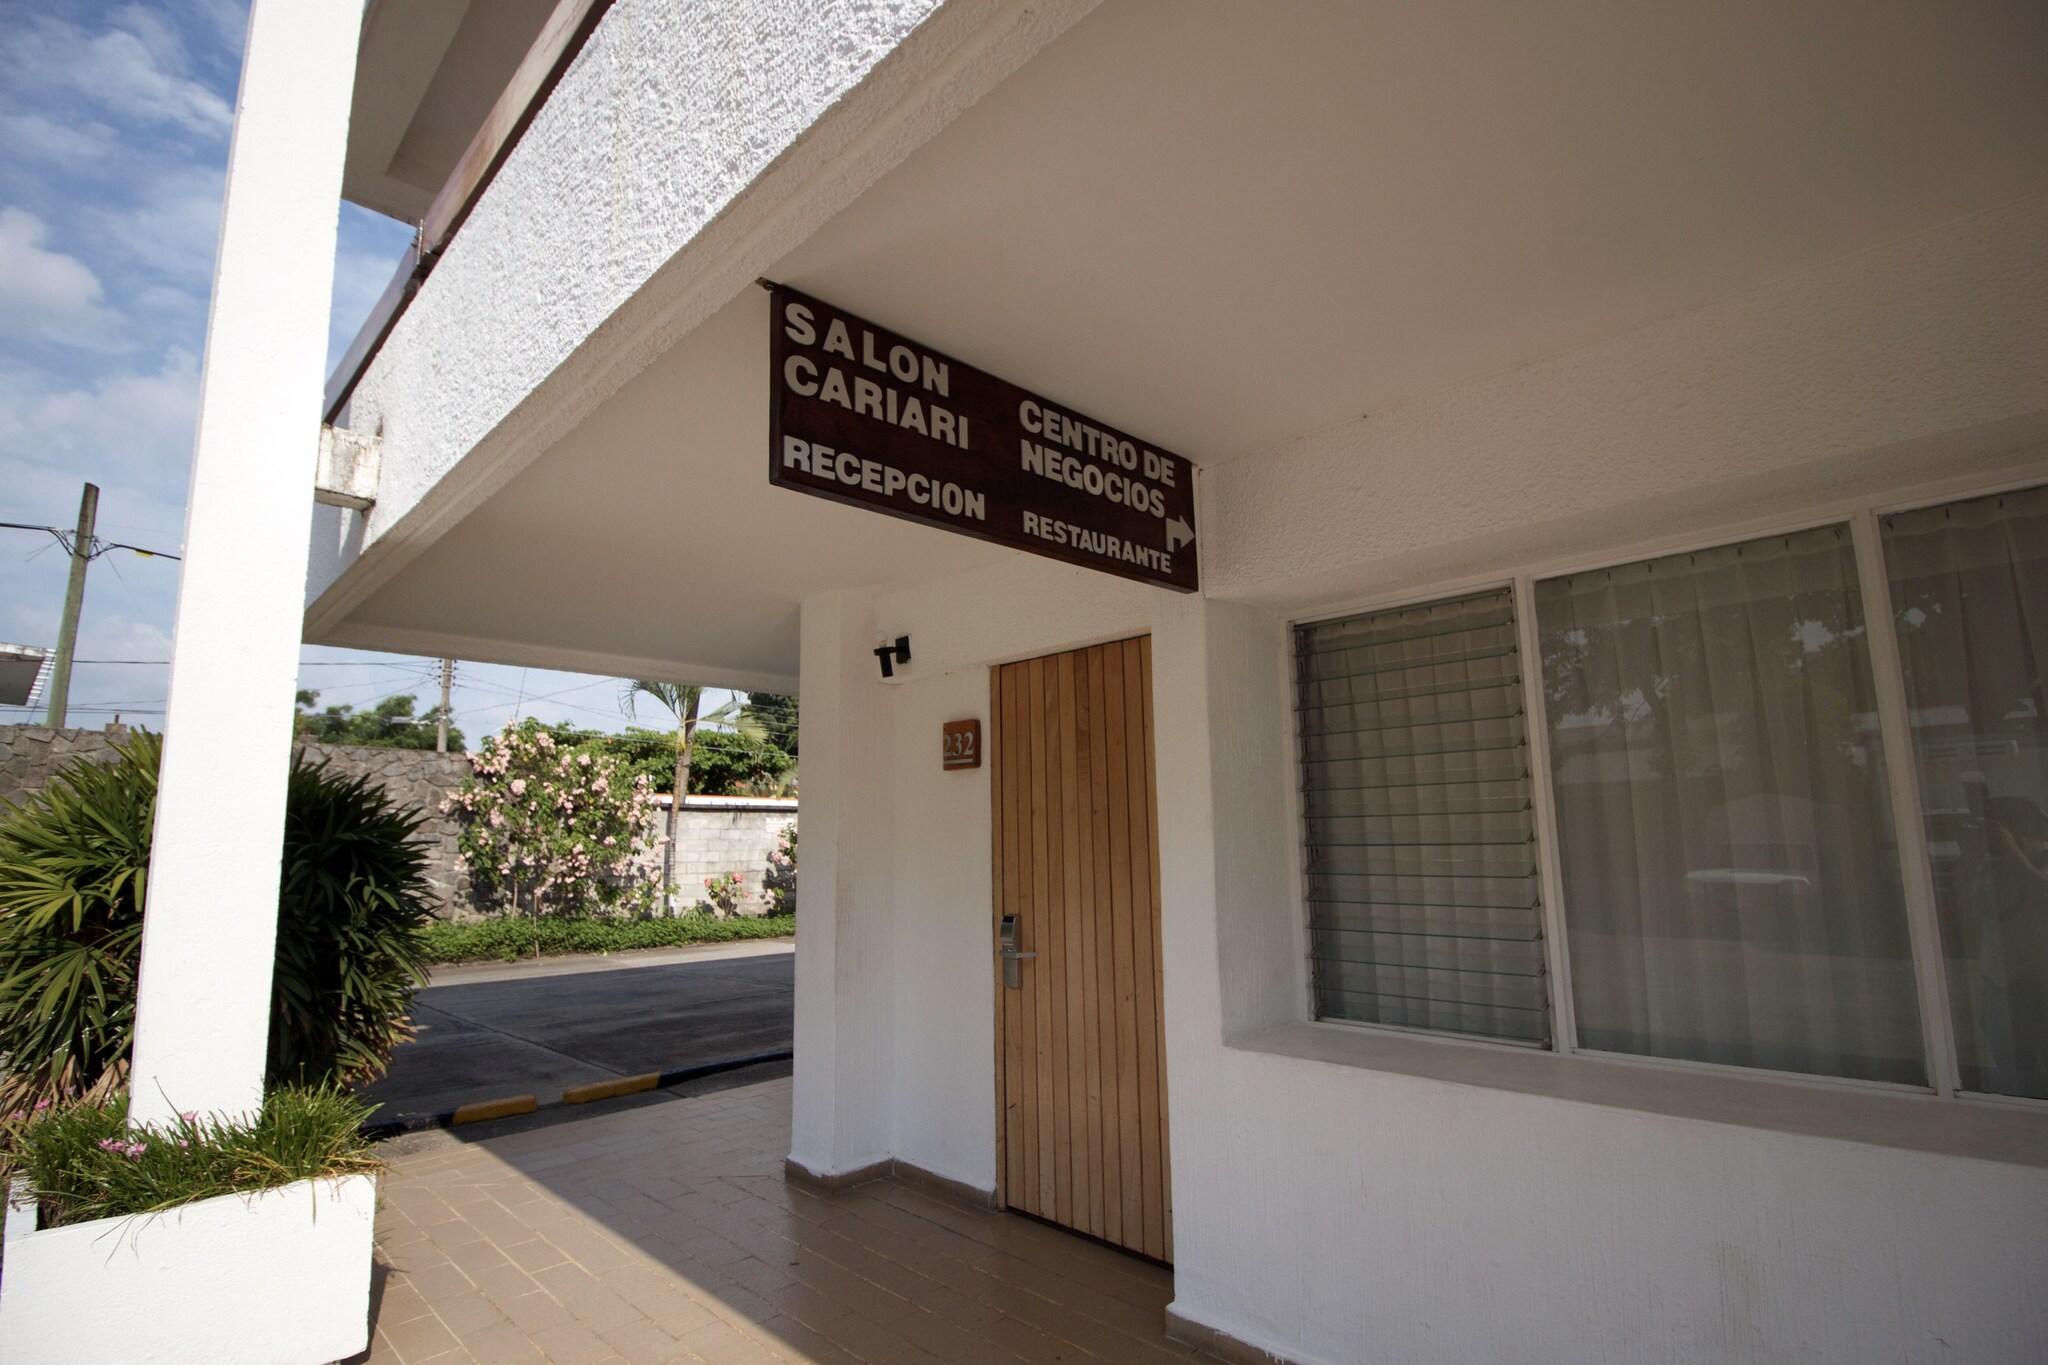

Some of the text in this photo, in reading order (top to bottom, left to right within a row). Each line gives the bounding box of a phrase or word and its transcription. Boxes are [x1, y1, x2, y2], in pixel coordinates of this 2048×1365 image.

[785, 303, 949, 397] SALON
[784, 355, 969, 450] CARIARI
[1019, 400, 1175, 487] CENTRO DE
[783, 435, 985, 520] RECEPCION
[1021, 440, 1165, 518] NEGOCIOS
[1023, 511, 1172, 574] RESTAURANTE
[943, 732, 974, 756] 232
